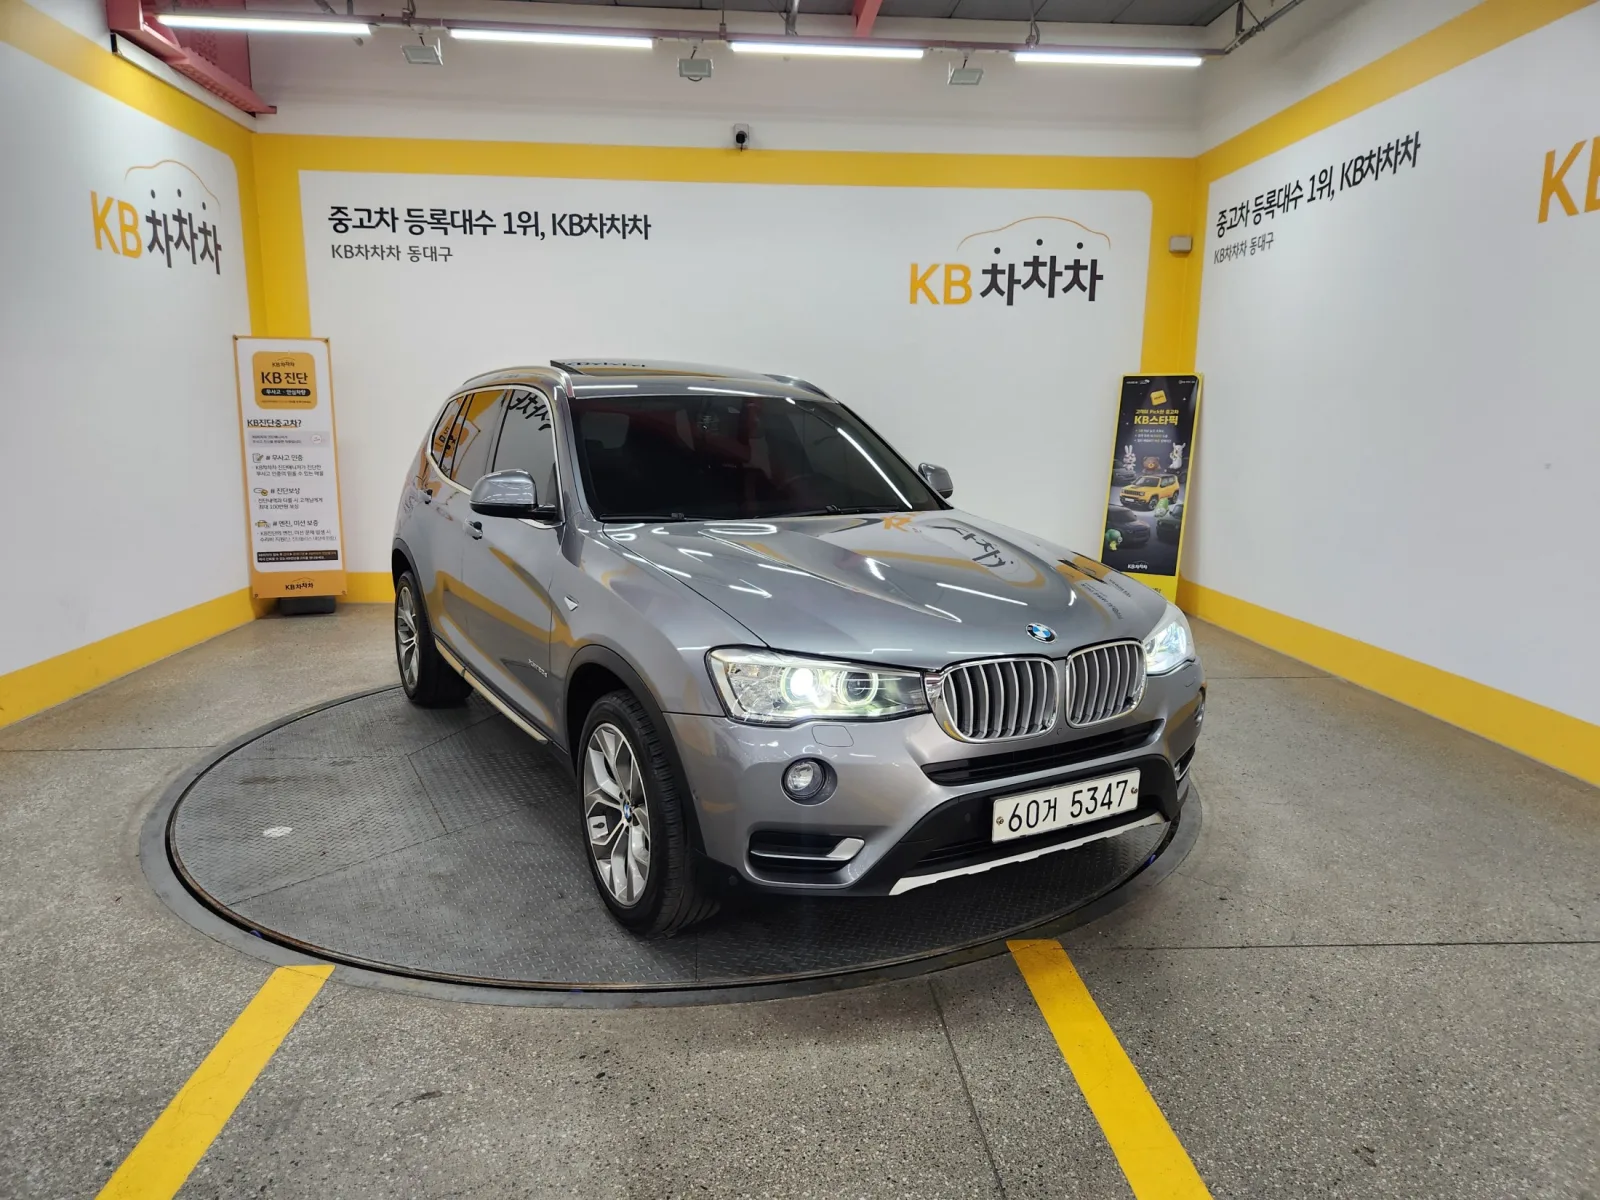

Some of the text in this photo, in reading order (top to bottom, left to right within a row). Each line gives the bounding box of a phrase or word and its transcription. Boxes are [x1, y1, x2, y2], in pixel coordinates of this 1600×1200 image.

[1216, 131, 1422, 239] 중고차 등록대수 1위, KB차차차
[90, 190, 222, 275] KB 차차차
[328, 206, 652, 241] 중고차 등록대수 1위, KB차차차
[331, 243, 454, 263] KB차차차 동대구
[1213, 231, 1275, 265] KB차차차 동대구
[909, 255, 1104, 306] KB 차차차
[261, 371, 308, 385] KB 진단
[247, 419, 302, 428] KB진단중고차?
[1134, 415, 1179, 426] KB스타픽
[291, 454, 304, 462] 인증
[276, 487, 301, 495] 진단보상
[1008, 779, 1129, 832] 60거 5347
